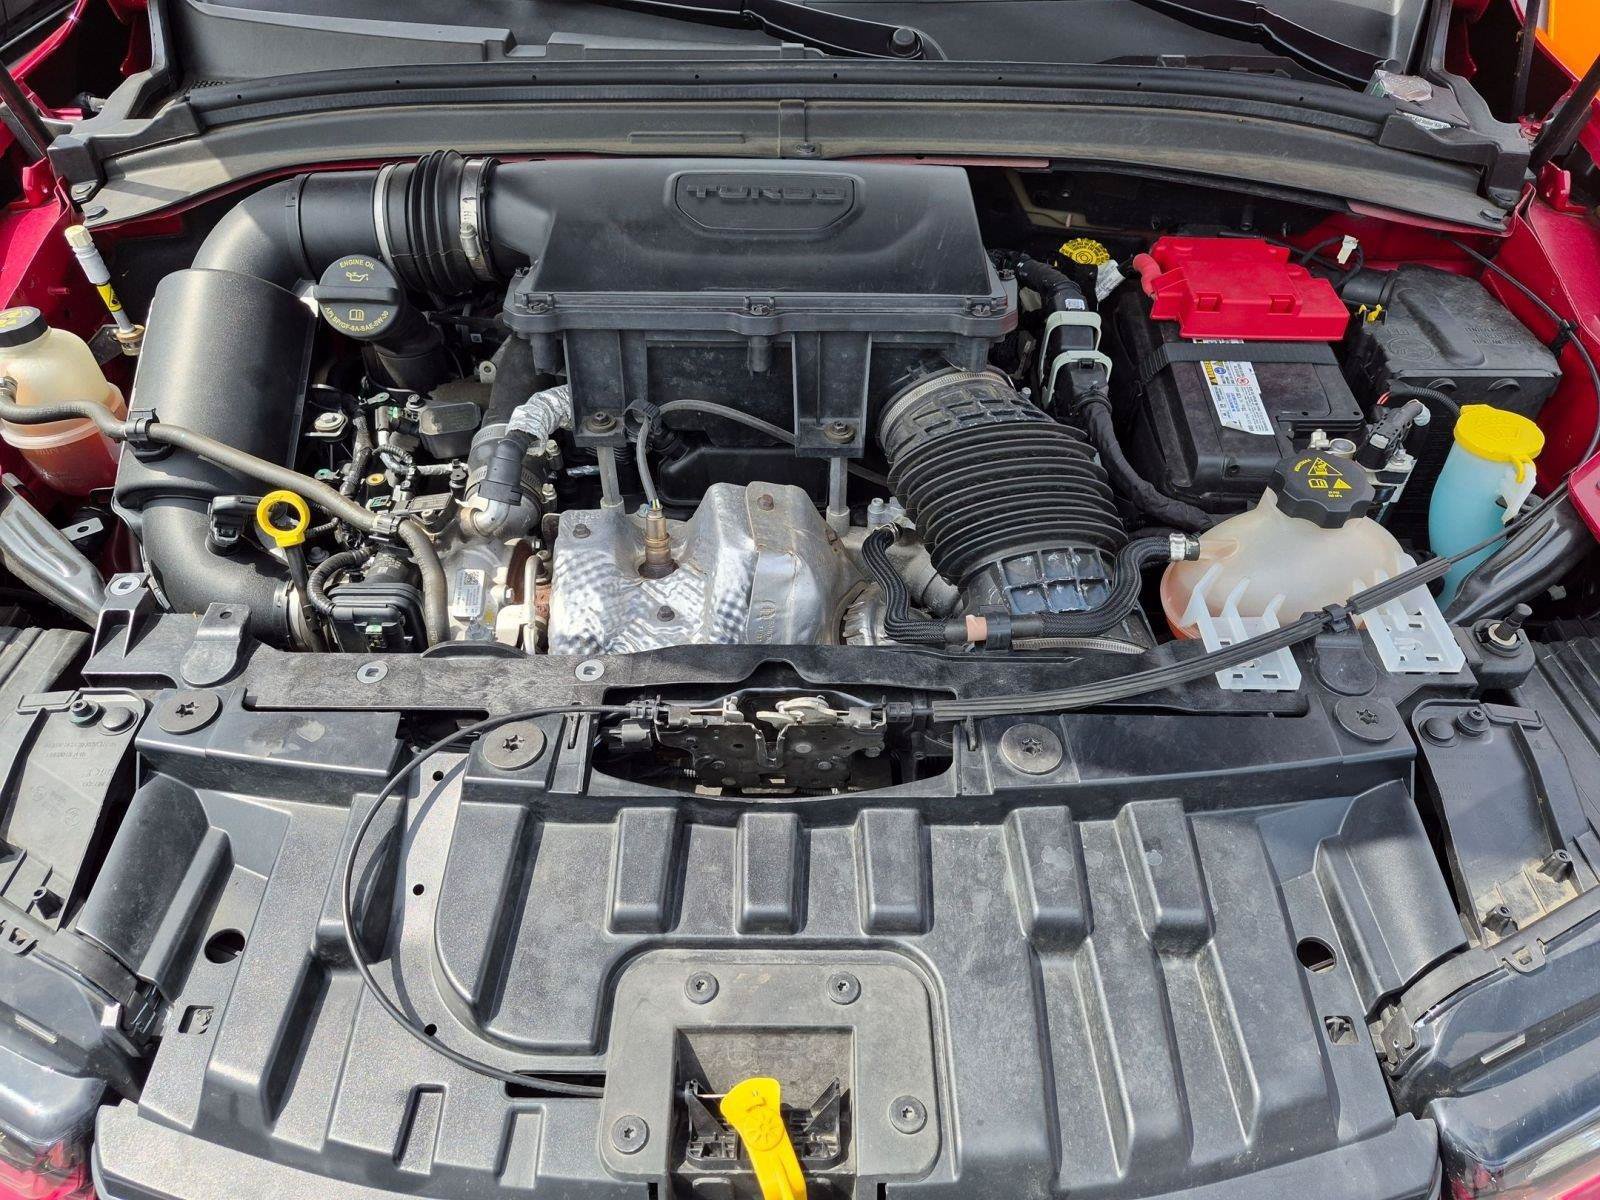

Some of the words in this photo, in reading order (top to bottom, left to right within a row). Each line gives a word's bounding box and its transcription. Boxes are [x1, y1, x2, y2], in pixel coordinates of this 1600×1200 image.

[686, 183, 846, 200] TURBO
[340, 258, 364, 268] ENGINE
[365, 261, 375, 271] OIL
